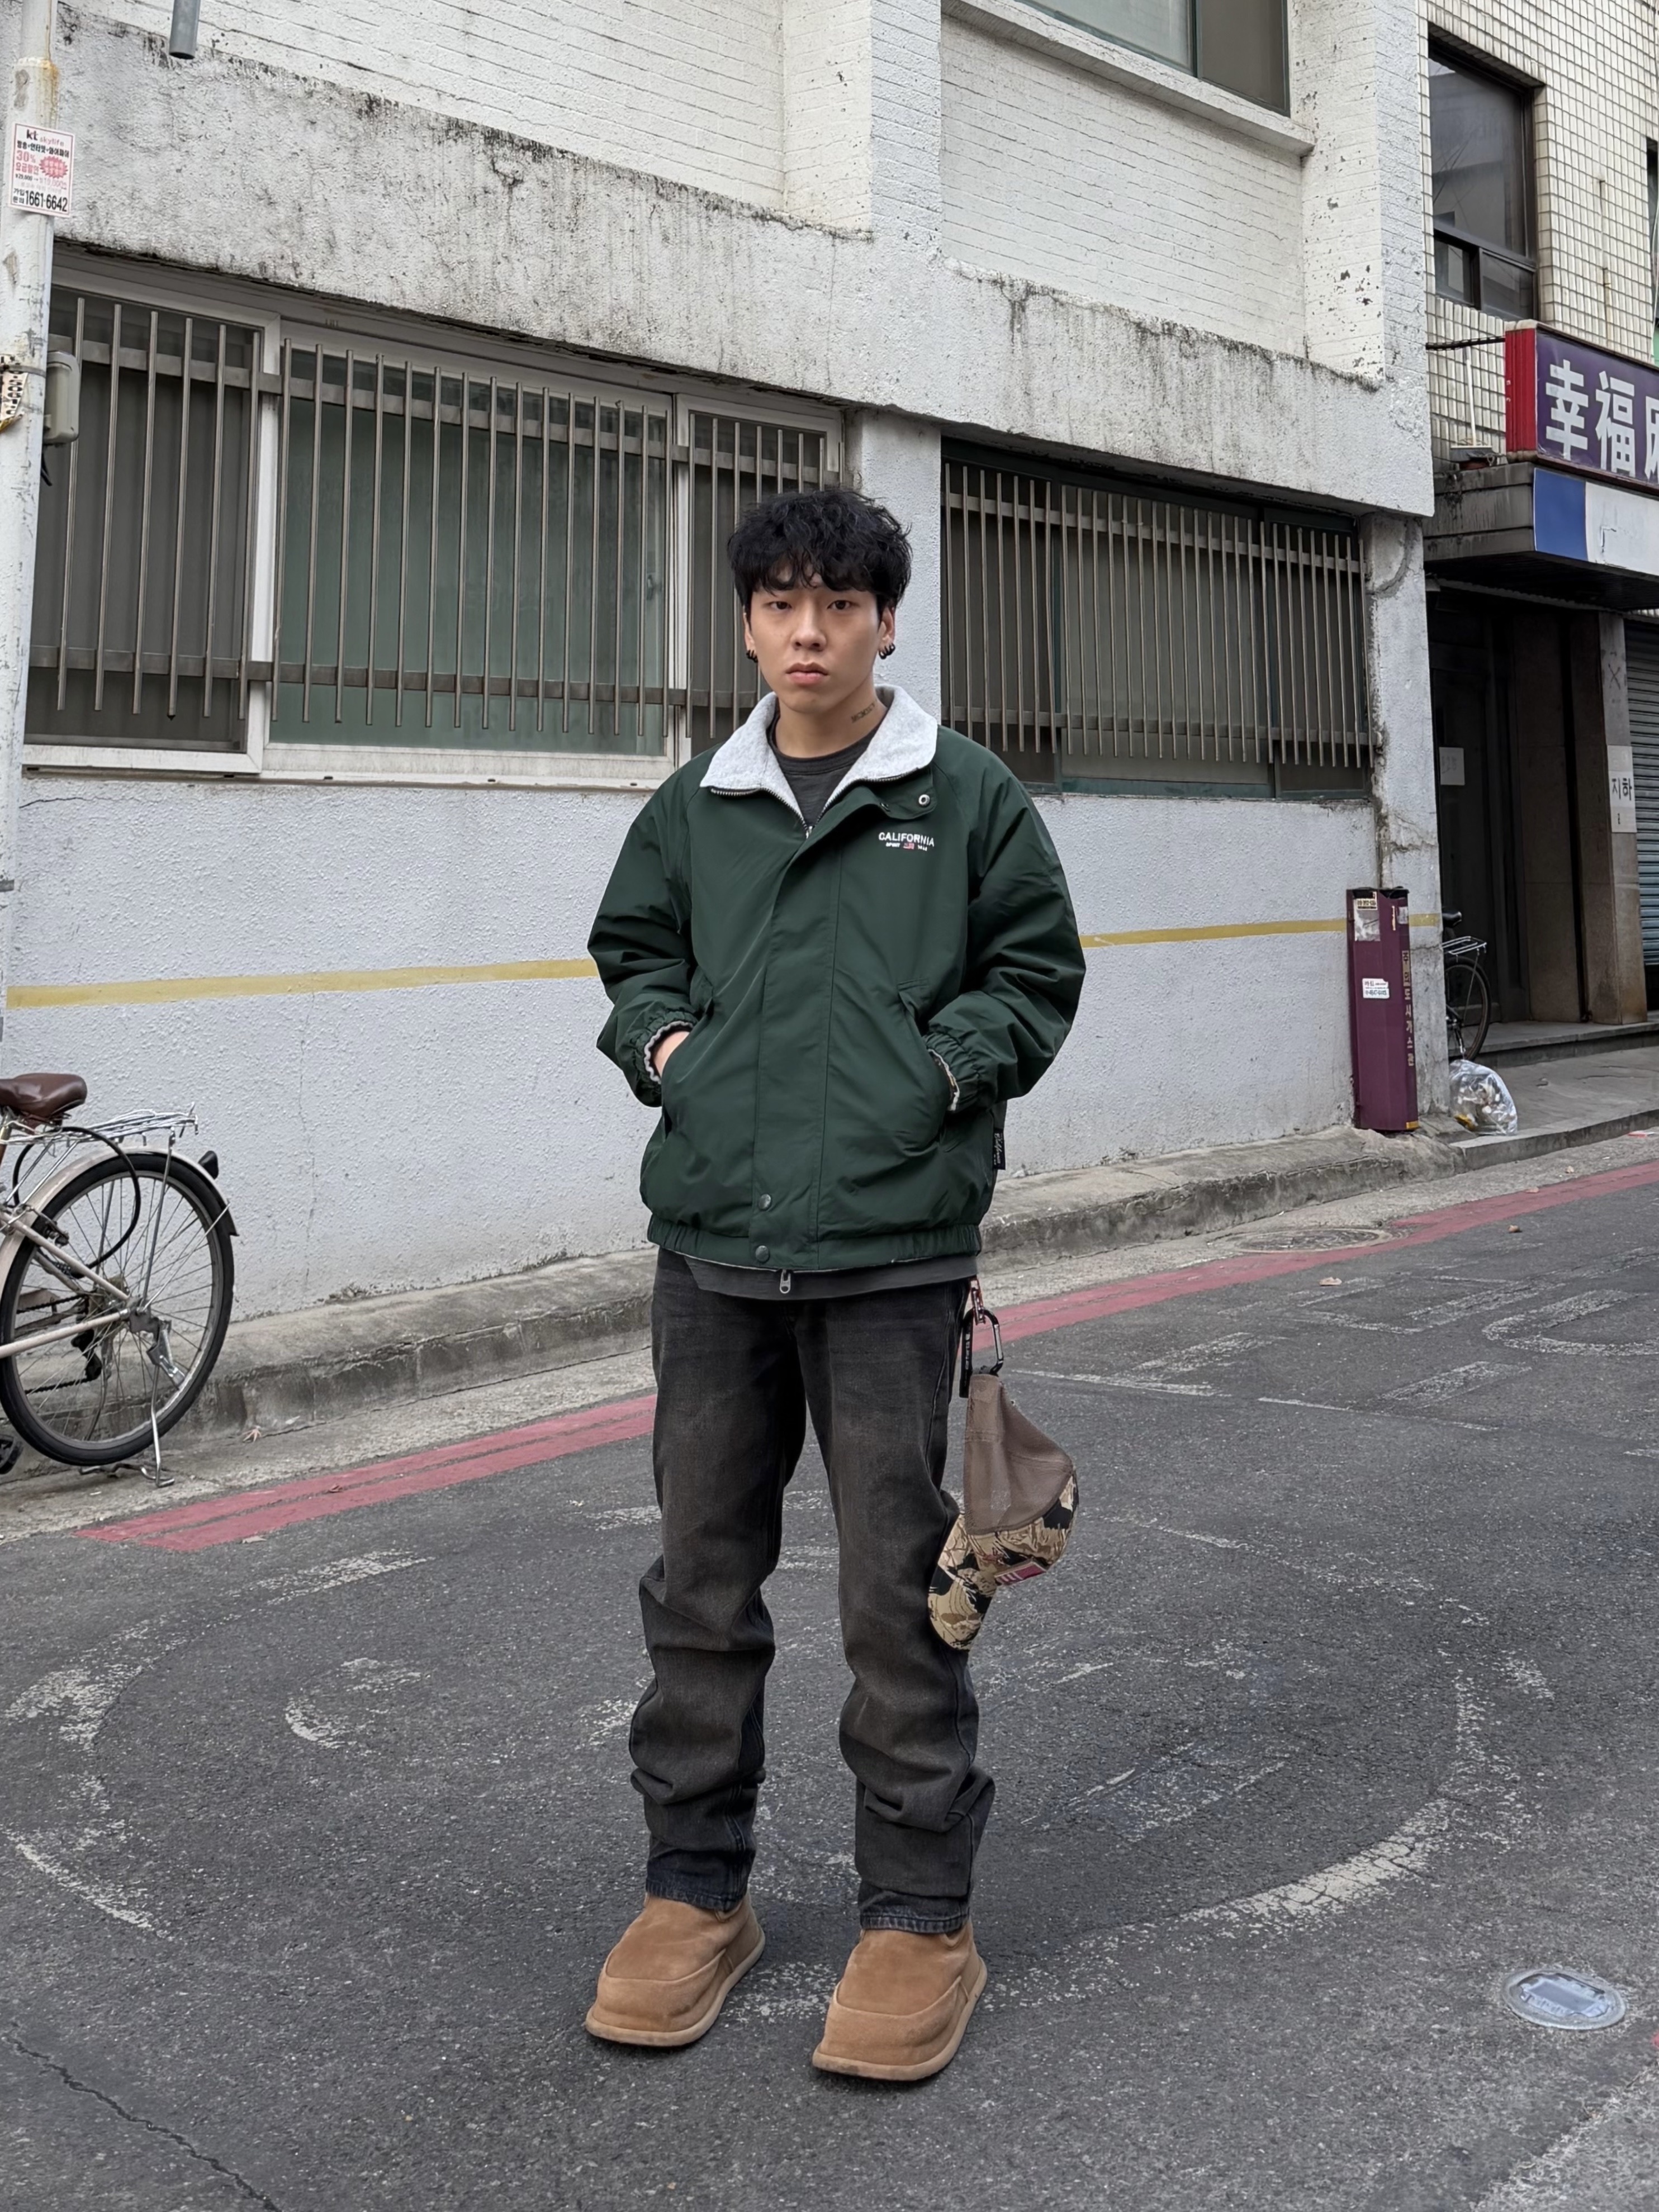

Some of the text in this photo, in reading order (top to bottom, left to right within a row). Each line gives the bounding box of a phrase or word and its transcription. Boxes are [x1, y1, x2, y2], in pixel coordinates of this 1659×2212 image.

[26, 129, 65, 146] kt skylife
[16, 150, 36, 164] 30%
[16, 162, 39, 175] 요금할인
[1611, 777, 1632, 801] 지하
[878, 832, 935, 847] CALIFORNIA
